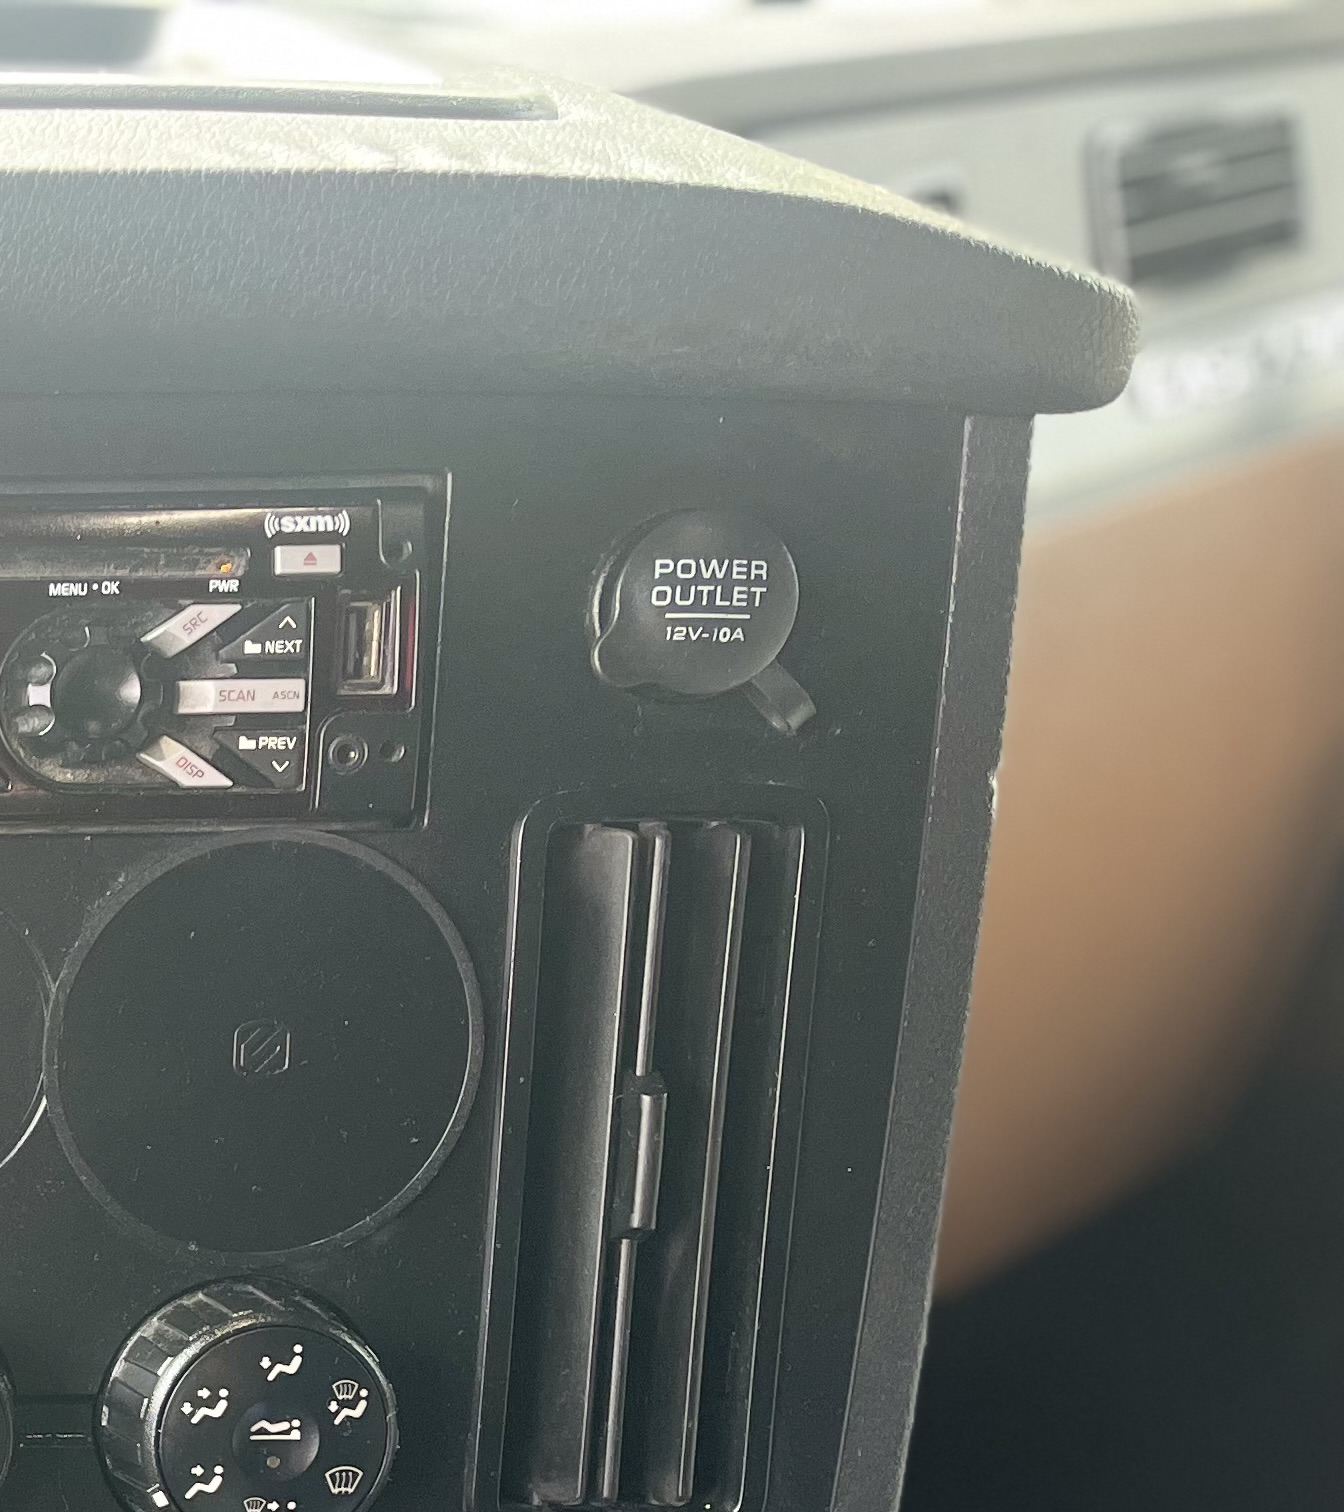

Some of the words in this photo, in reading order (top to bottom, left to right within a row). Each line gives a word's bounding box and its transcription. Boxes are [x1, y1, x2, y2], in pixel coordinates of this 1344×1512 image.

[654, 558, 768, 581] POWER
[48, 582, 88, 597] MENU
[101, 580, 120, 595] OK
[208, 578, 240, 593] PWR
[651, 584, 767, 607] OUTLET
[181, 611, 209, 636] SRC
[665, 626, 745, 643] 12V-10A
[264, 639, 303, 654] NEXT
[218, 689, 256, 703] SCAN
[271, 690, 300, 700] ASCN
[258, 736, 297, 750] PREV
[175, 756, 205, 780] DISP
